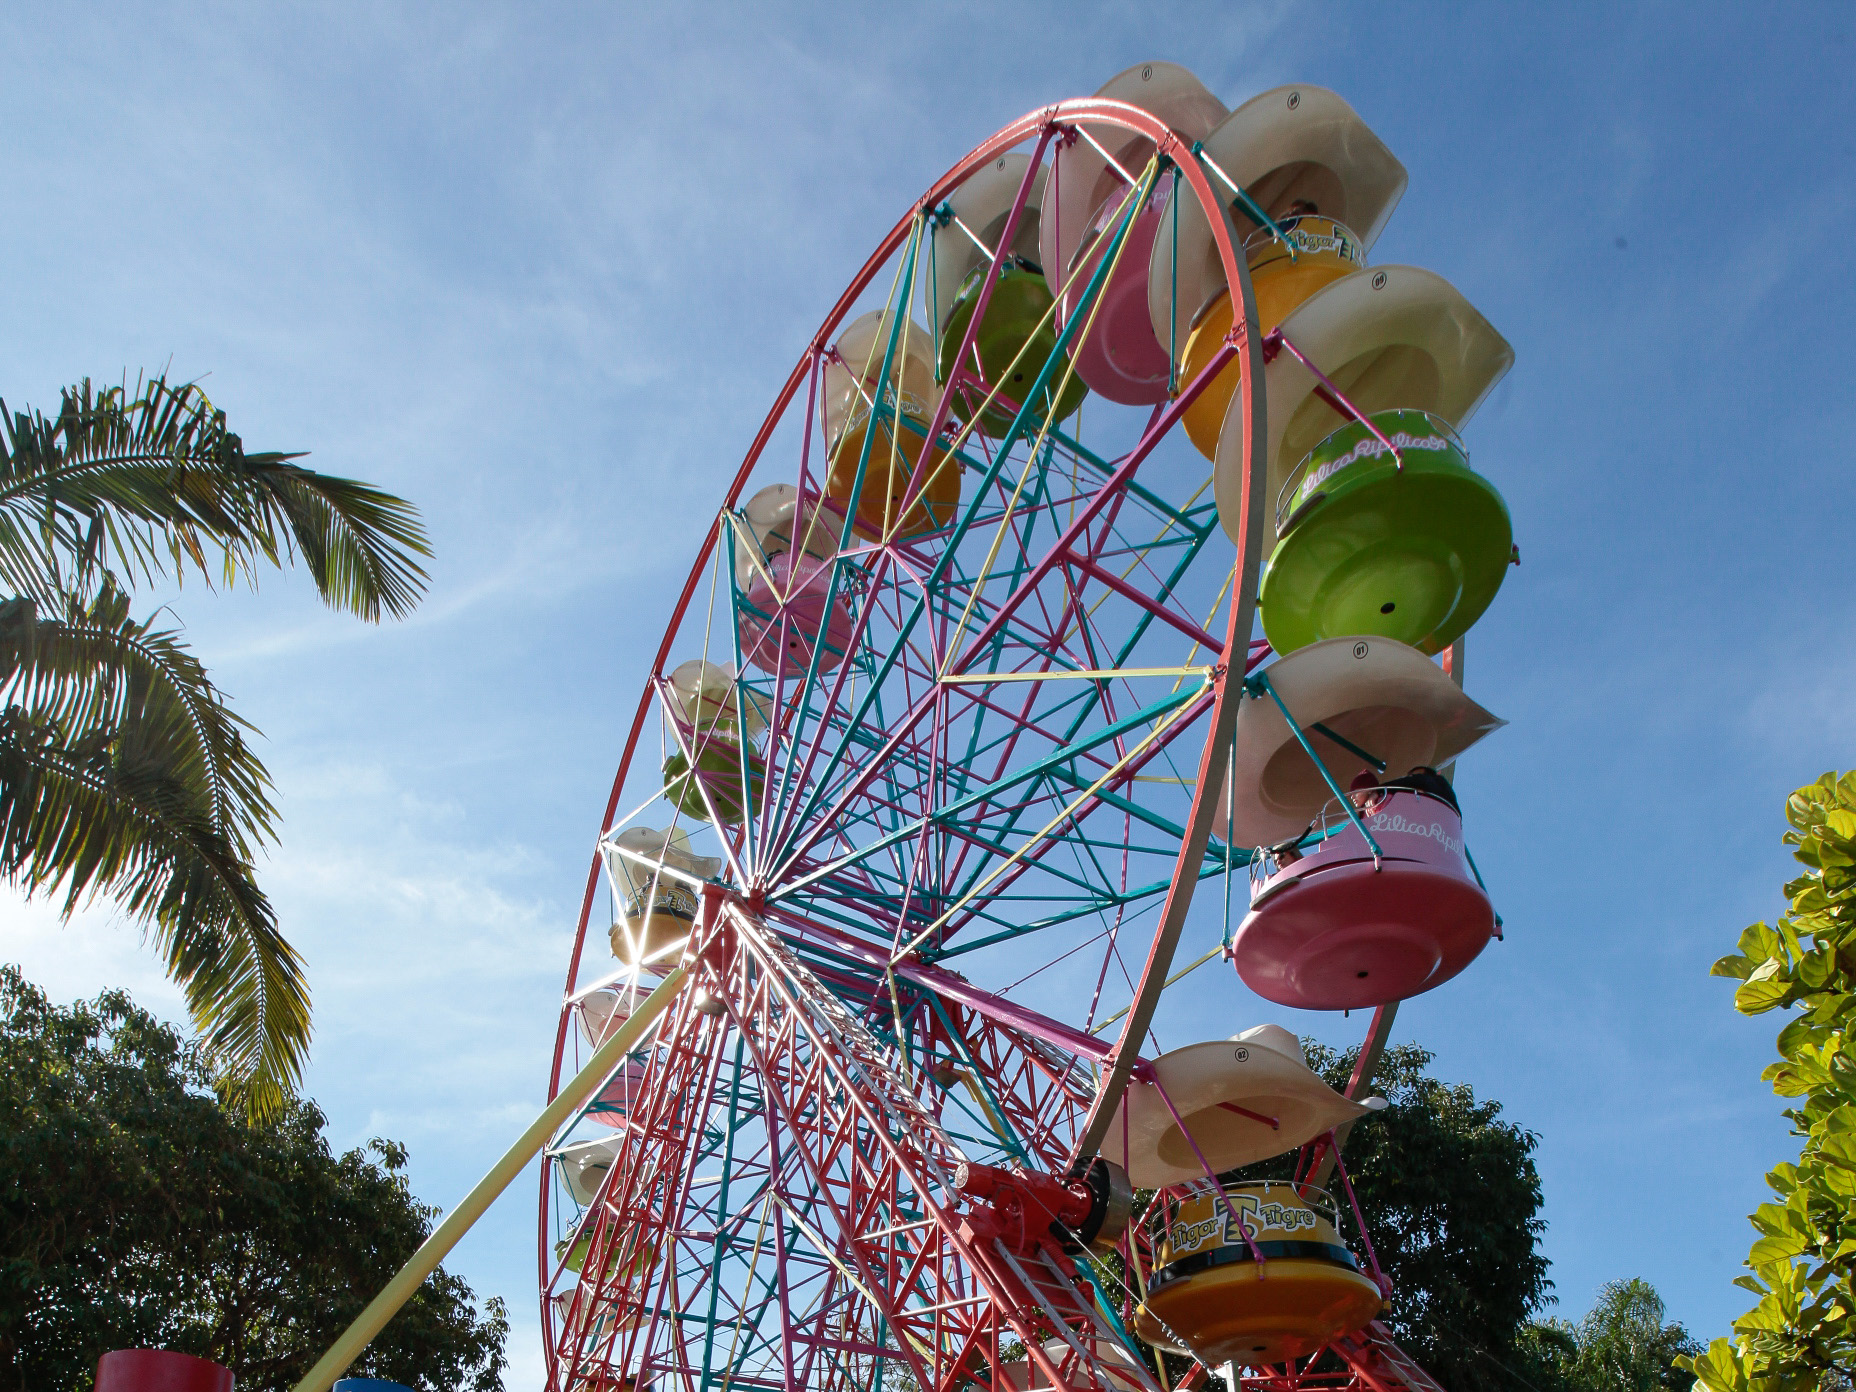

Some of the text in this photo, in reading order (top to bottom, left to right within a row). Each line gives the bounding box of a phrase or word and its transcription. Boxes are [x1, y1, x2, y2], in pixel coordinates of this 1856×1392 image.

[1356, 645, 1365, 656] 01
[1169, 1218, 1221, 1253] Tigor
[1260, 1202, 1316, 1232] Tigre
